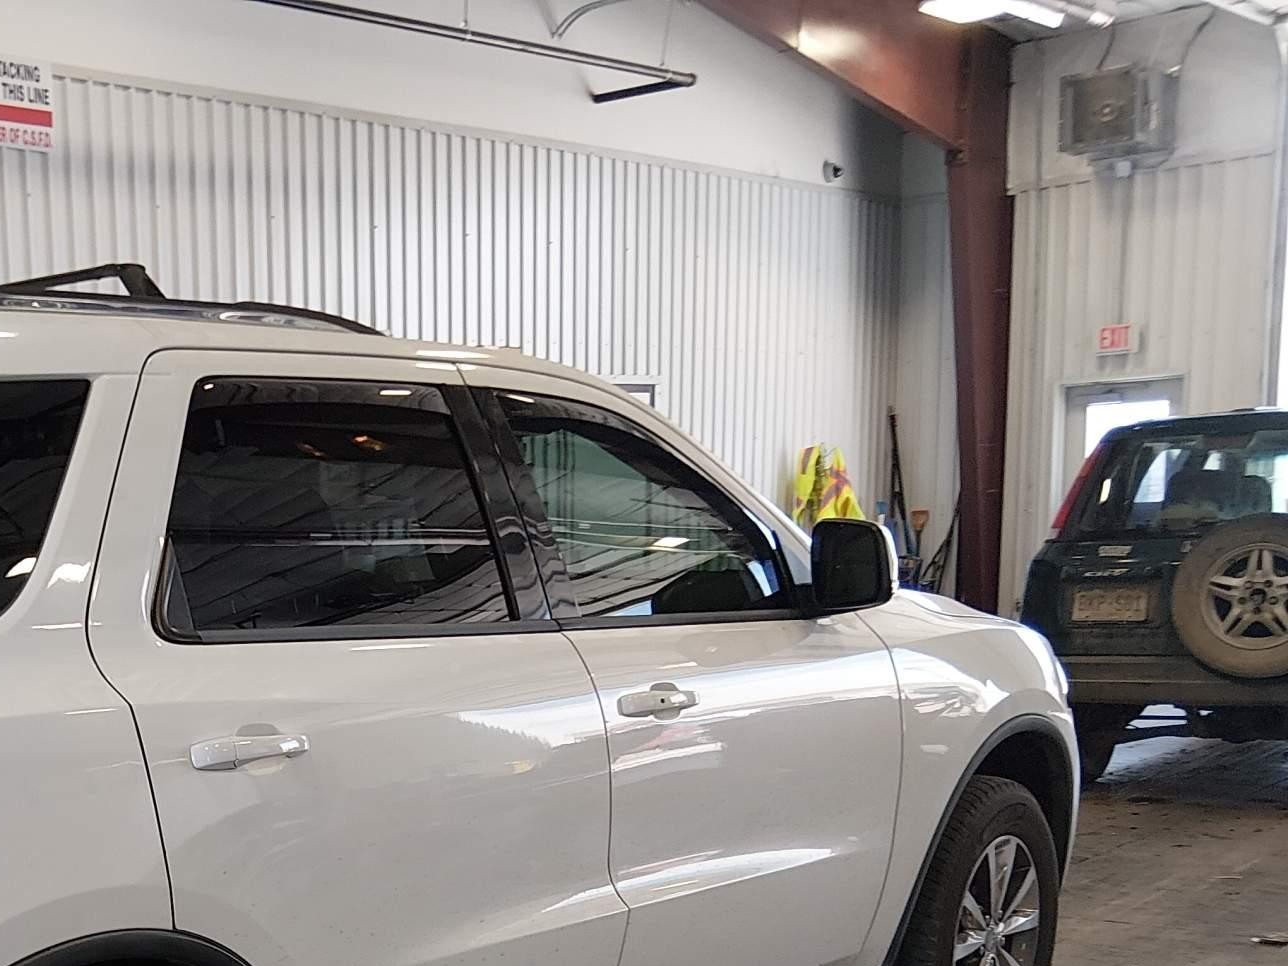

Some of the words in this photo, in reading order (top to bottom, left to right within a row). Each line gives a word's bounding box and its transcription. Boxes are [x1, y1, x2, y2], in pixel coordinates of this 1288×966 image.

[1, 82, 25, 102] THIS
[27, 86, 50, 105] LINE
[9, 127, 20, 143] OF
[1100, 326, 1129, 349] EXIT
